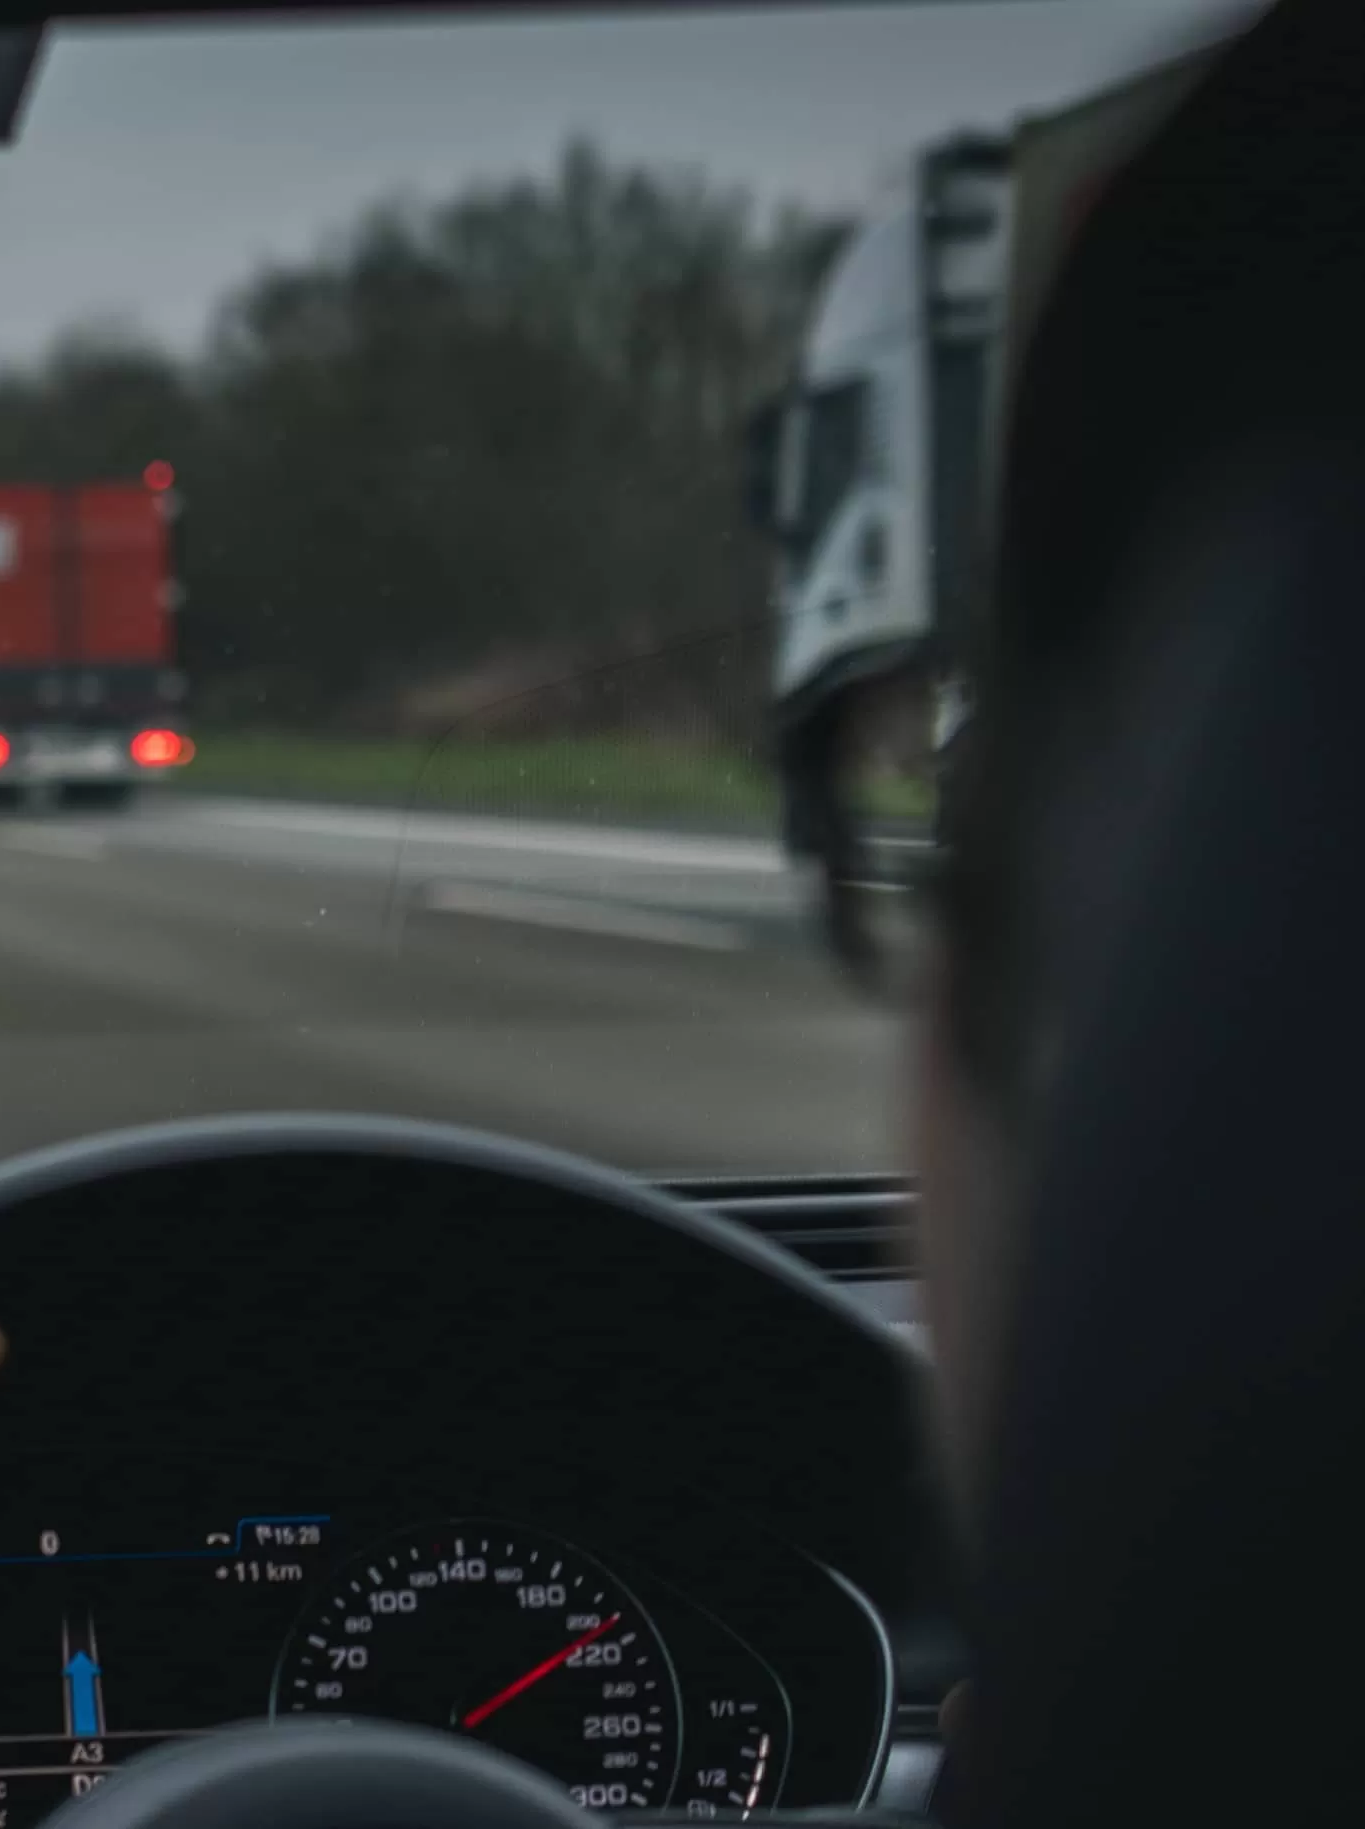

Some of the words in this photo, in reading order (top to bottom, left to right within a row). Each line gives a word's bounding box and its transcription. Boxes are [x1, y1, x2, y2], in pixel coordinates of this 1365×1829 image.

[233, 1560, 260, 1582] 11
[266, 1561, 302, 1581] km
[438, 1561, 486, 1582] 140
[369, 1590, 417, 1613] 100
[517, 1584, 566, 1608] 180
[566, 1613, 601, 1630] 200
[328, 1647, 367, 1670] 70
[566, 1643, 621, 1667] 220
[602, 1681, 637, 1699] 240
[709, 1699, 735, 1718] 1/1
[583, 1713, 641, 1740] 260
[70, 1741, 104, 1764] A3
[602, 1751, 638, 1769] 280
[72, 1773, 105, 1797] D
[697, 1768, 727, 1788] 1/2
[569, 1784, 627, 1808] 300
